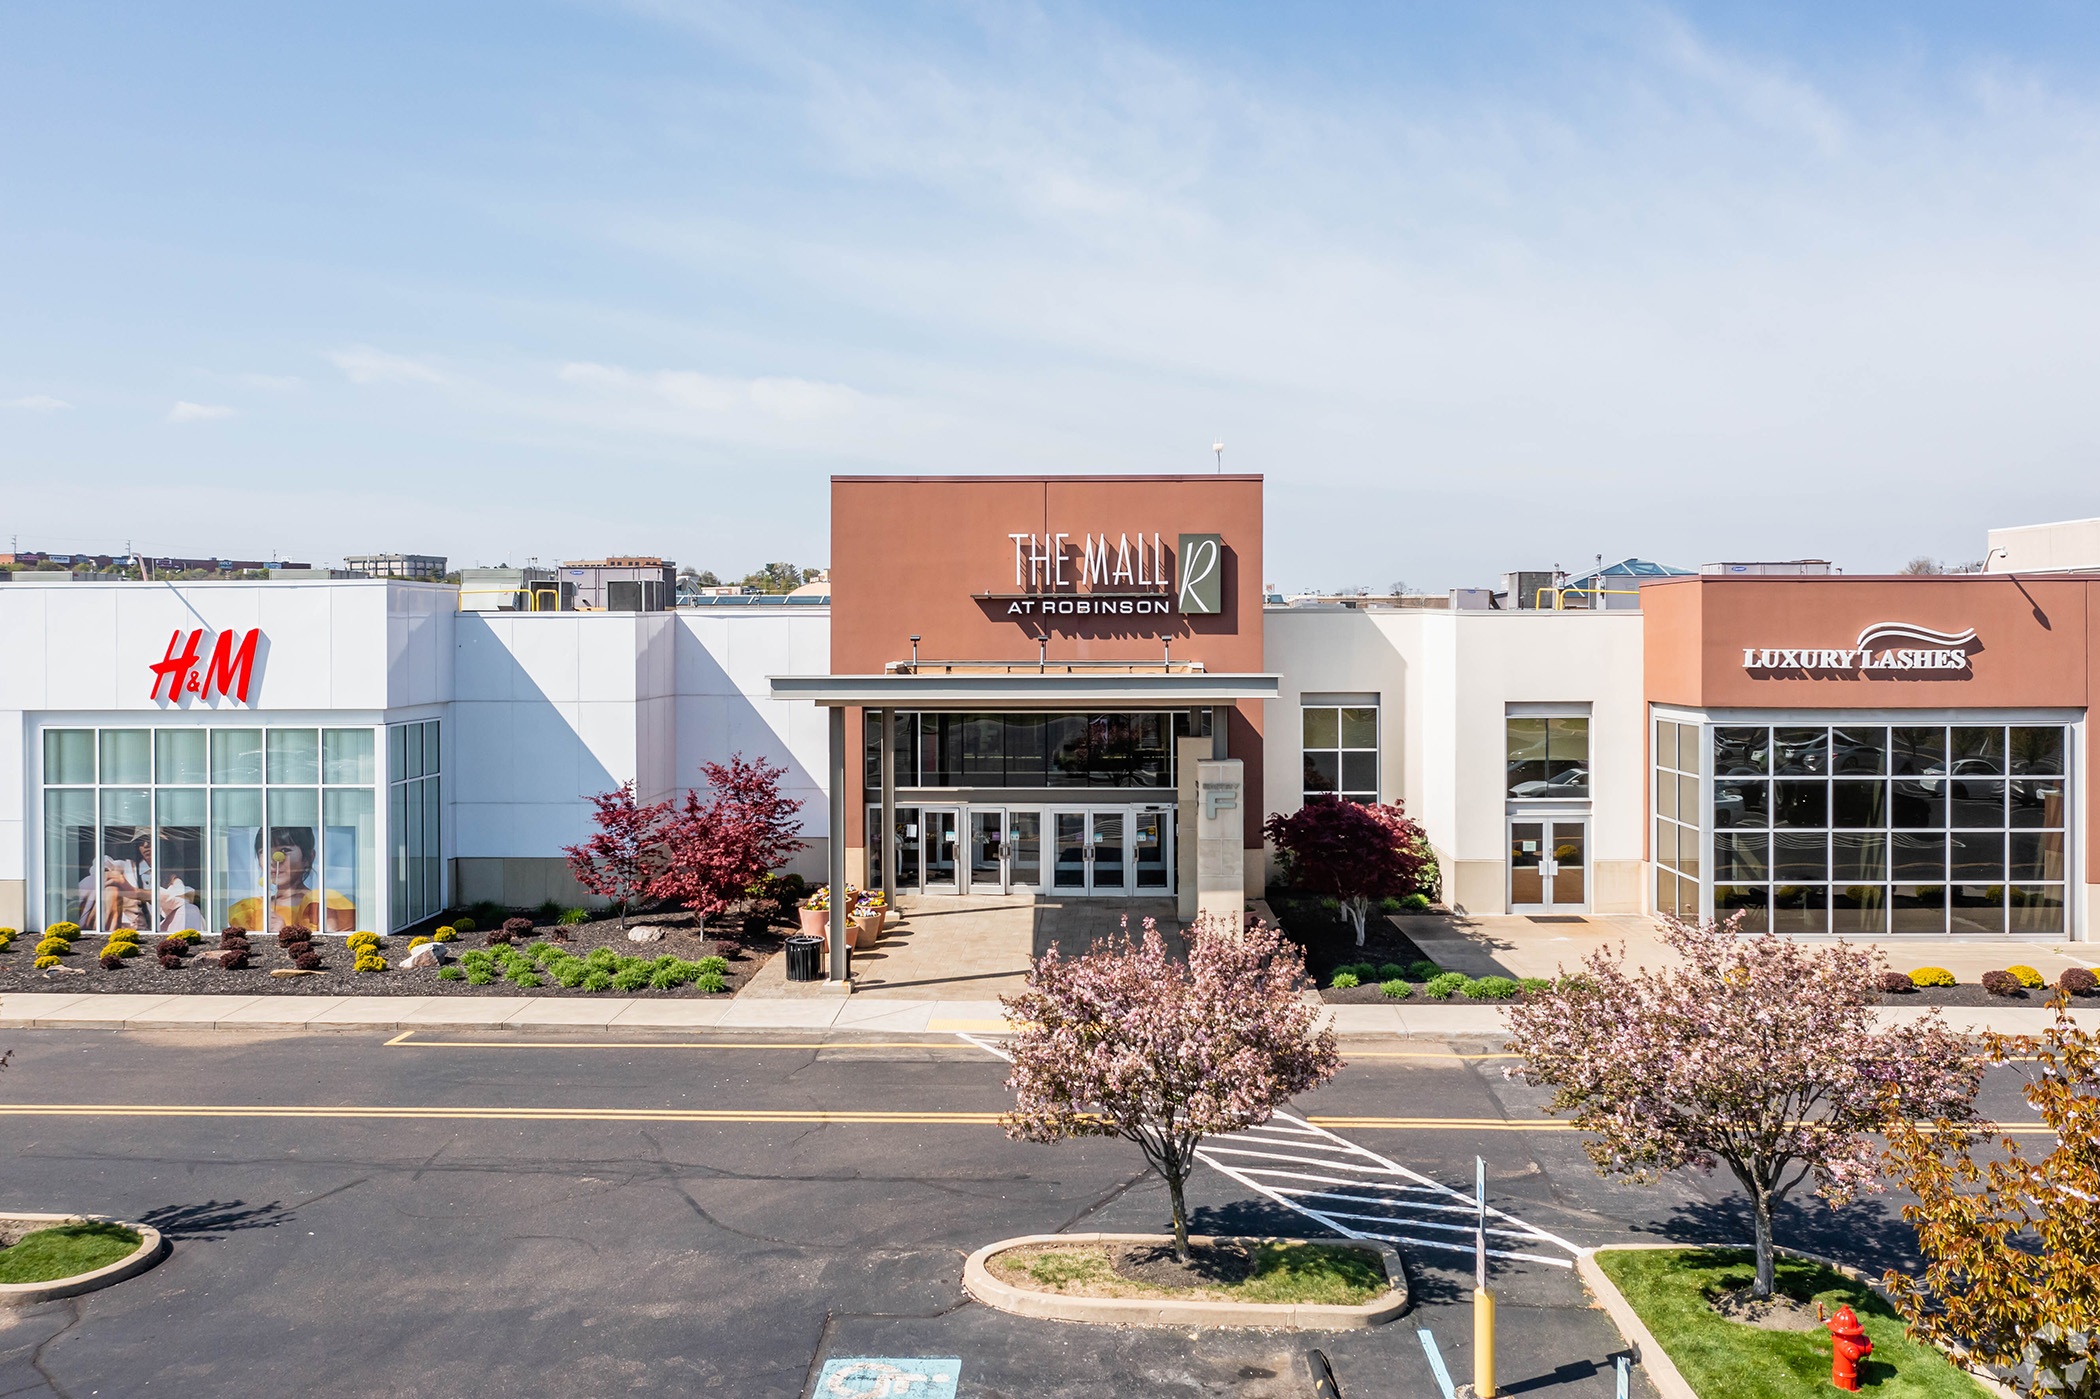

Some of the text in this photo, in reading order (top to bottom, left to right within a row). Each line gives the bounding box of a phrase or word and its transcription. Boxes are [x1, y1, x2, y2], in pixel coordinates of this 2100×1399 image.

[1008, 532, 1168, 586] THE MALL
[1179, 540, 1217, 613] R
[1007, 601, 1169, 615] AT ROBINSON
[149, 628, 259, 703] H&M
[1742, 648, 1966, 669] LUXURY LASHES
[1206, 791, 1237, 820] F
